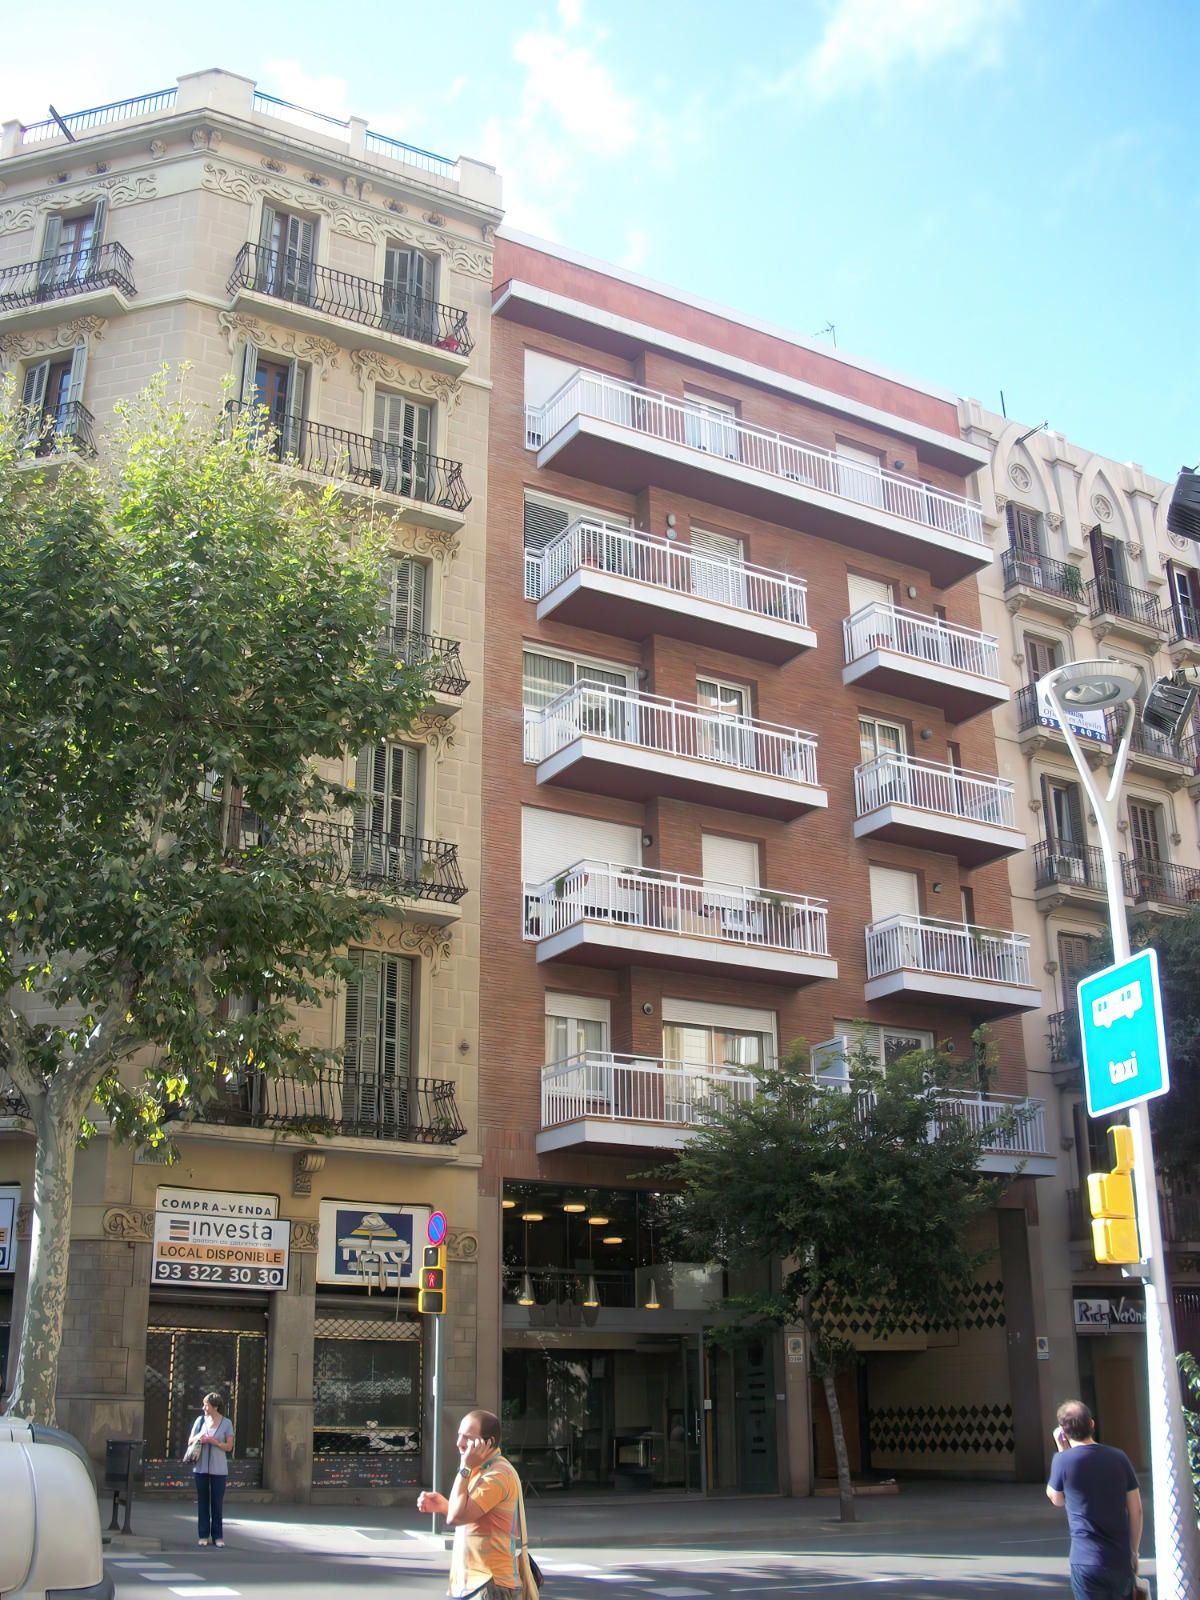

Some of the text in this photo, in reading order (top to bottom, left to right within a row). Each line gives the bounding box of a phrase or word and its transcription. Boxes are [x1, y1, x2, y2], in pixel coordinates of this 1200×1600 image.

[1109, 1050, 1139, 1085] taxi
[161, 1198, 272, 1216] COMPRA-VENDA
[160, 1246, 282, 1263] LOCAL DISPONIBLE
[158, 1263, 281, 1285] 93 322 30 30
